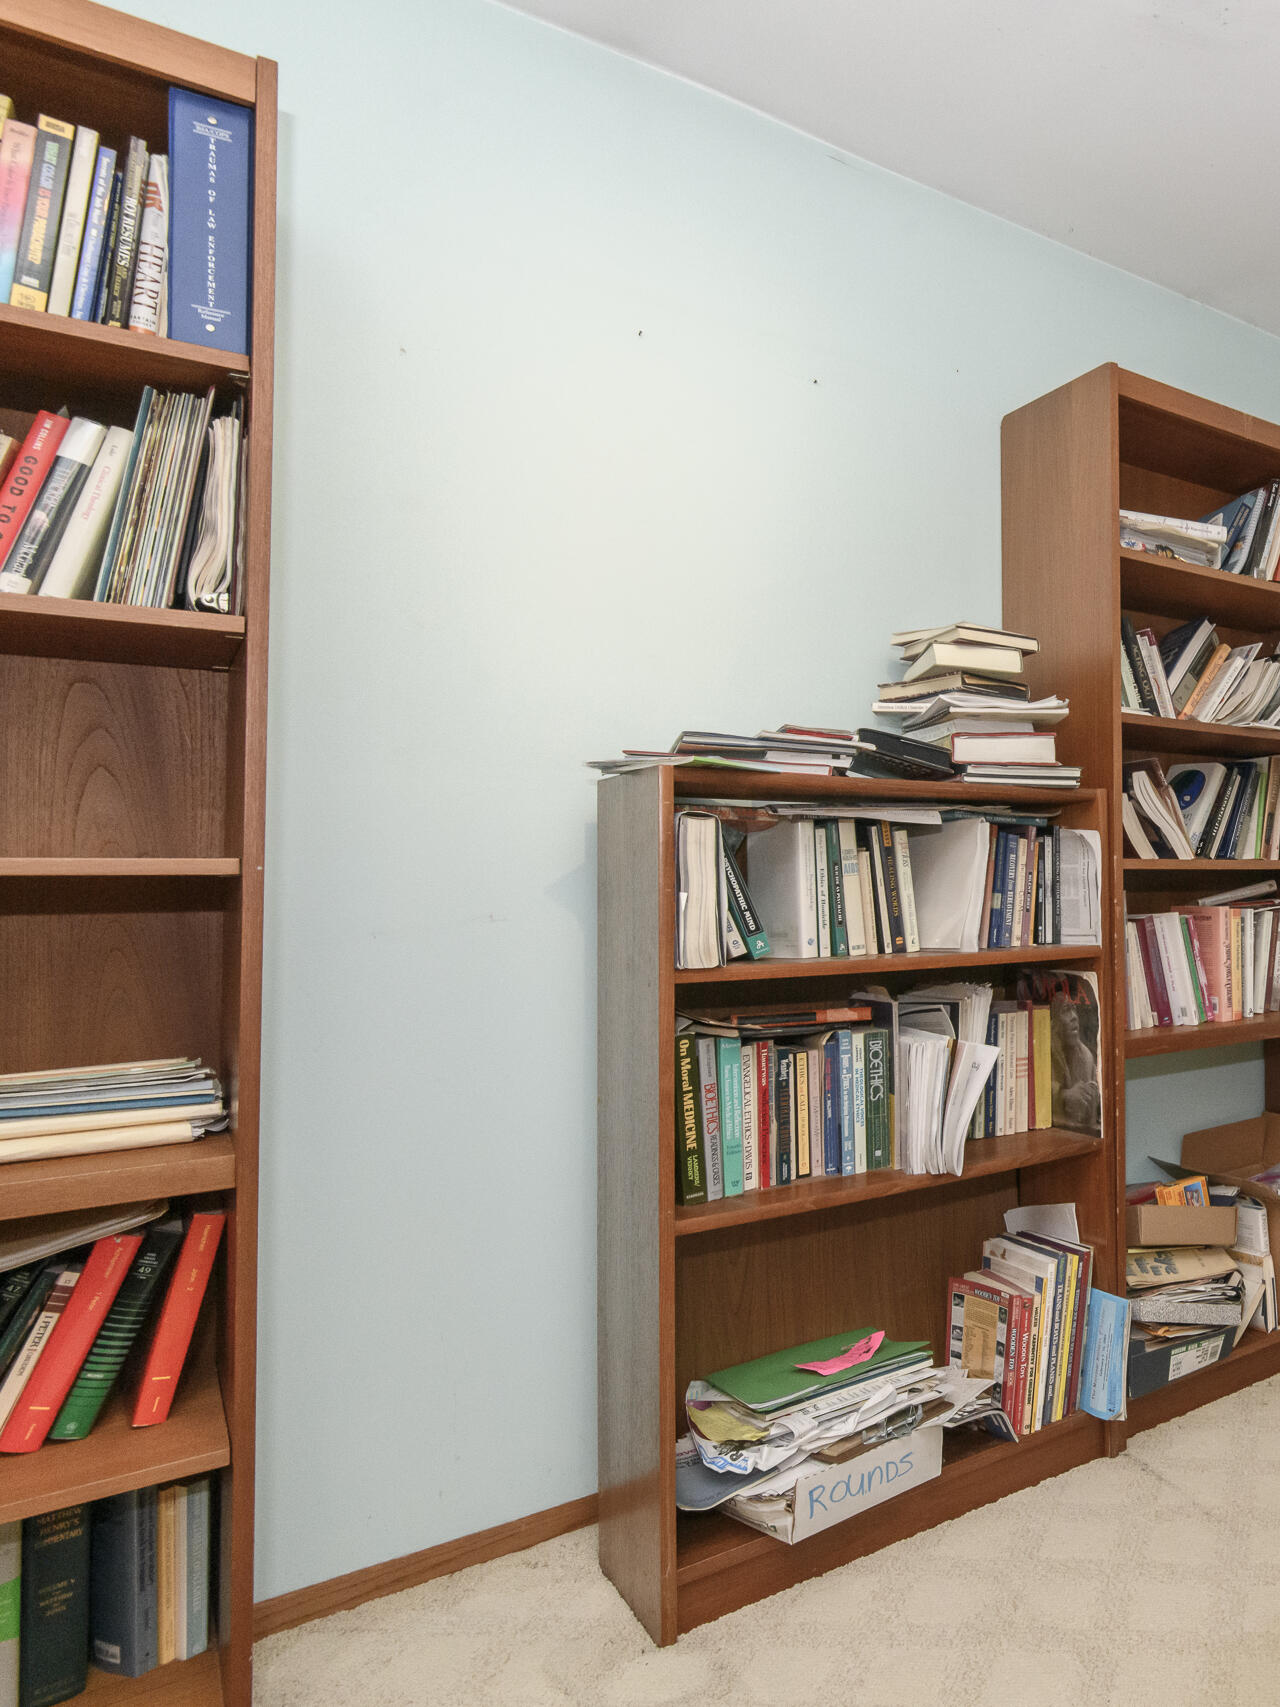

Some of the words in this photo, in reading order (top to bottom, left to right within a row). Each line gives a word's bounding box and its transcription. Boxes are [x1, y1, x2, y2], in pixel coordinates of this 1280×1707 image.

[206, 137, 218, 183] TRAUMAS
[38, 162, 56, 190] COLOR
[206, 188, 217, 203] OF
[206, 208, 217, 229] LAW
[116, 216, 135, 267] RESUMES
[131, 240, 165, 315] HEART
[205, 235, 217, 308] ENFORCEMENT
[31, 426, 49, 452] COLLINS
[8, 452, 39, 499] GOOD
[1129, 642, 1147, 679] ACTING
[1140, 679, 1153, 700] OUT
[1210, 785, 1234, 836] SELF-STARVATION
[843, 862, 859, 874] AIDS
[886, 855, 897, 889] HEALING
[1007, 853, 1016, 879] RECOVERY
[721, 856, 749, 911] PSYCHOPATHIC
[742, 909, 756, 932] MIND
[819, 889, 826, 898] of
[890, 889, 900, 917] WORDS
[1004, 890, 1013, 926] BEREAVEMENT
[678, 1038, 689, 1057] On
[679, 1057, 693, 1092] Moral
[742, 1053, 751, 1108] EVANGELICAL
[868, 1039, 884, 1101] BIOETHICS
[681, 1092, 697, 1152] MEDICINE
[702, 1081, 720, 1135] BIOETHICS
[743, 1109, 752, 1140] ETHICS
[709, 1134, 719, 1163] READINGS
[744, 1145, 752, 1169] DAVIS
[711, 1167, 720, 1187] CASES
[137, 1265, 152, 1275] 49
[1054, 1282, 1064, 1311] TRAINS
[1053, 1309, 1061, 1322] and
[28, 1317, 50, 1351] PETER
[1008, 1327, 1017, 1357] WOODEN
[1051, 1321, 1060, 1343] BOATS
[1029, 1333, 1037, 1365] CARPENTRY
[1049, 1343, 1058, 1357] and
[1007, 1357, 1015, 1371] TOY
[1047, 1357, 1057, 1384] PLANES
[1026, 1378, 1034, 1405] CHILDREN
[807, 1451, 914, 1519] ROUNDS
